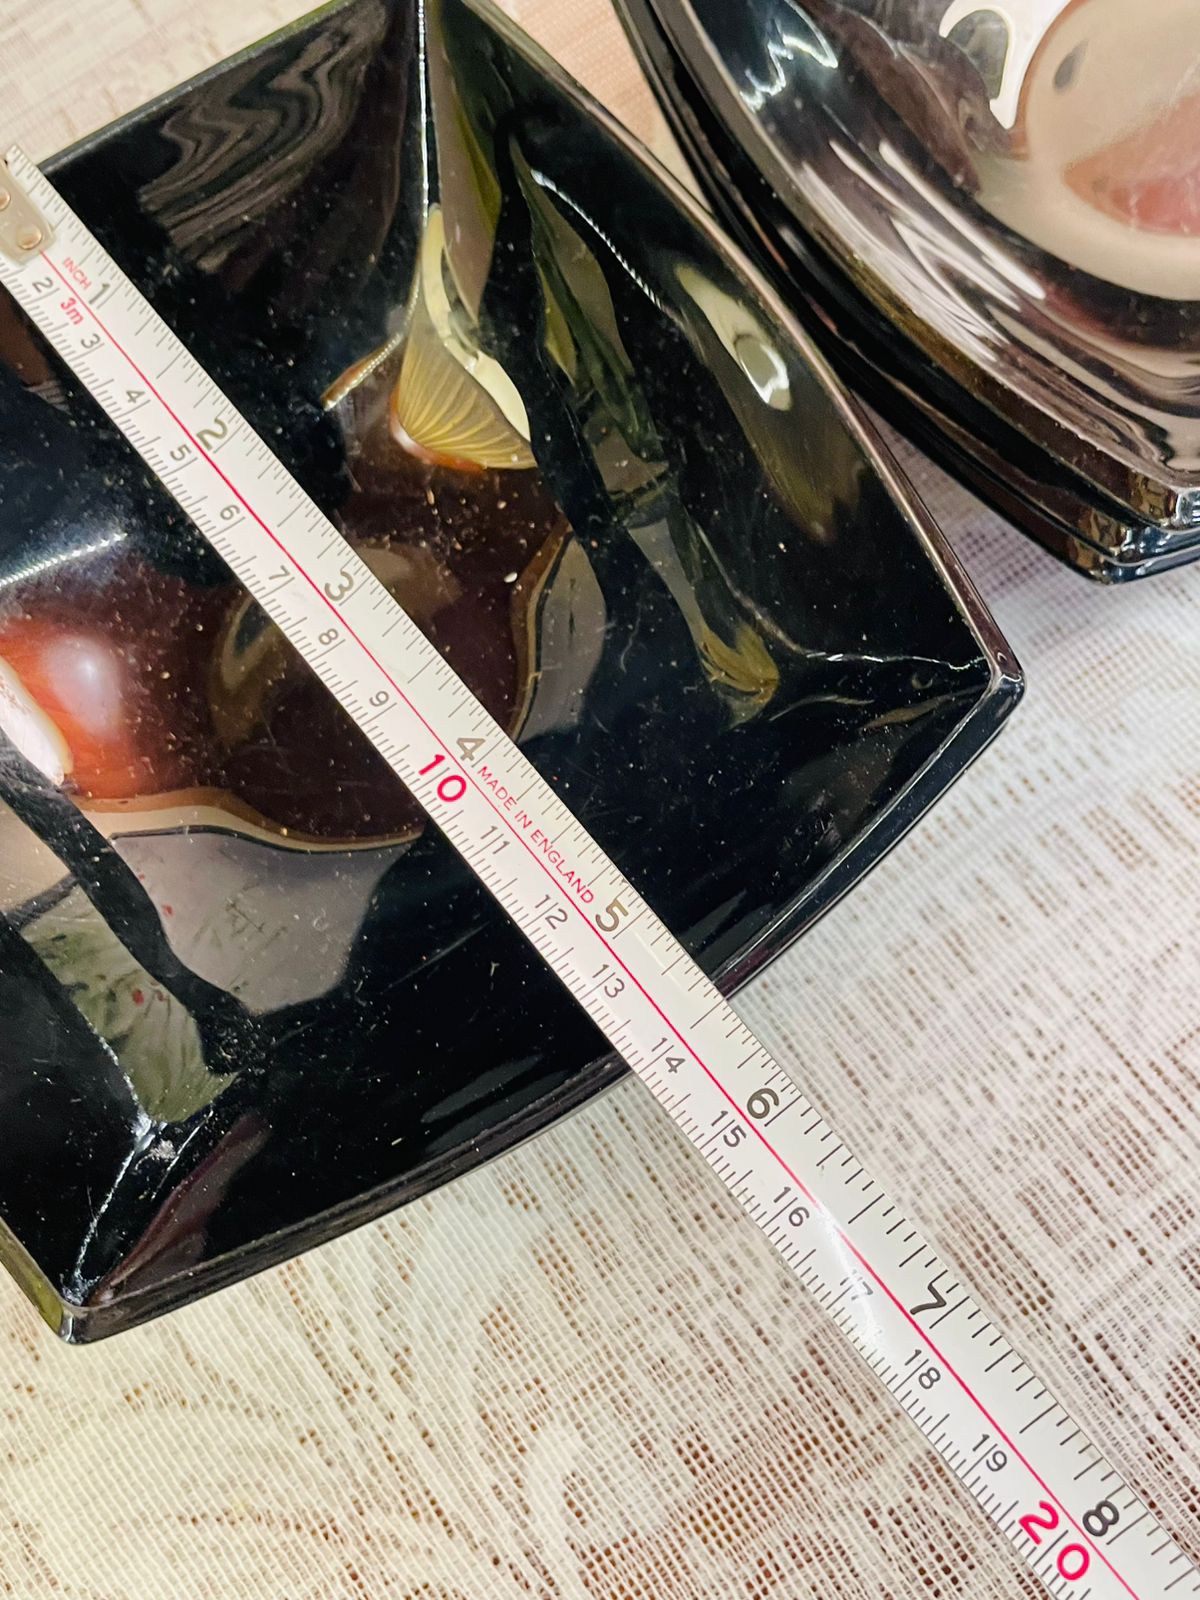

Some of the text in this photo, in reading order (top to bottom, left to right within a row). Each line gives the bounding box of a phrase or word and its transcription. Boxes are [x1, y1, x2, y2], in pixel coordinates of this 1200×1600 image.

[32, 277, 53, 293] 2
[63, 257, 91, 290] INCH
[89, 284, 110, 304] 1
[60, 297, 84, 325] 3m
[81, 333, 100, 349] 3
[126, 389, 145, 403] 4
[196, 418, 228, 450] 2
[170, 444, 189, 461] 5
[220, 504, 240, 520] 6
[269, 565, 290, 581] 7
[324, 570, 354, 602] 3
[318, 628, 339, 646] 8
[369, 690, 389, 707] 9
[456, 737, 486, 761] 4
[419, 754, 467, 802] 10
[477, 766, 594, 904] MADE IN ENGLAND
[480, 826, 510, 854] 11
[535, 894, 568, 930] 12
[595, 899, 629, 932] 5
[592, 964, 625, 998] 13
[652, 1037, 686, 1074] 14
[746, 1087, 780, 1120] 6
[711, 1110, 747, 1148] 15
[773, 1186, 810, 1227] 16
[910, 1282, 947, 1315] 7
[904, 1349, 941, 1390] 18
[972, 1433, 1008, 1473] 19
[1082, 1500, 1120, 1538] 8
[1018, 1500, 1090, 1581] 20
